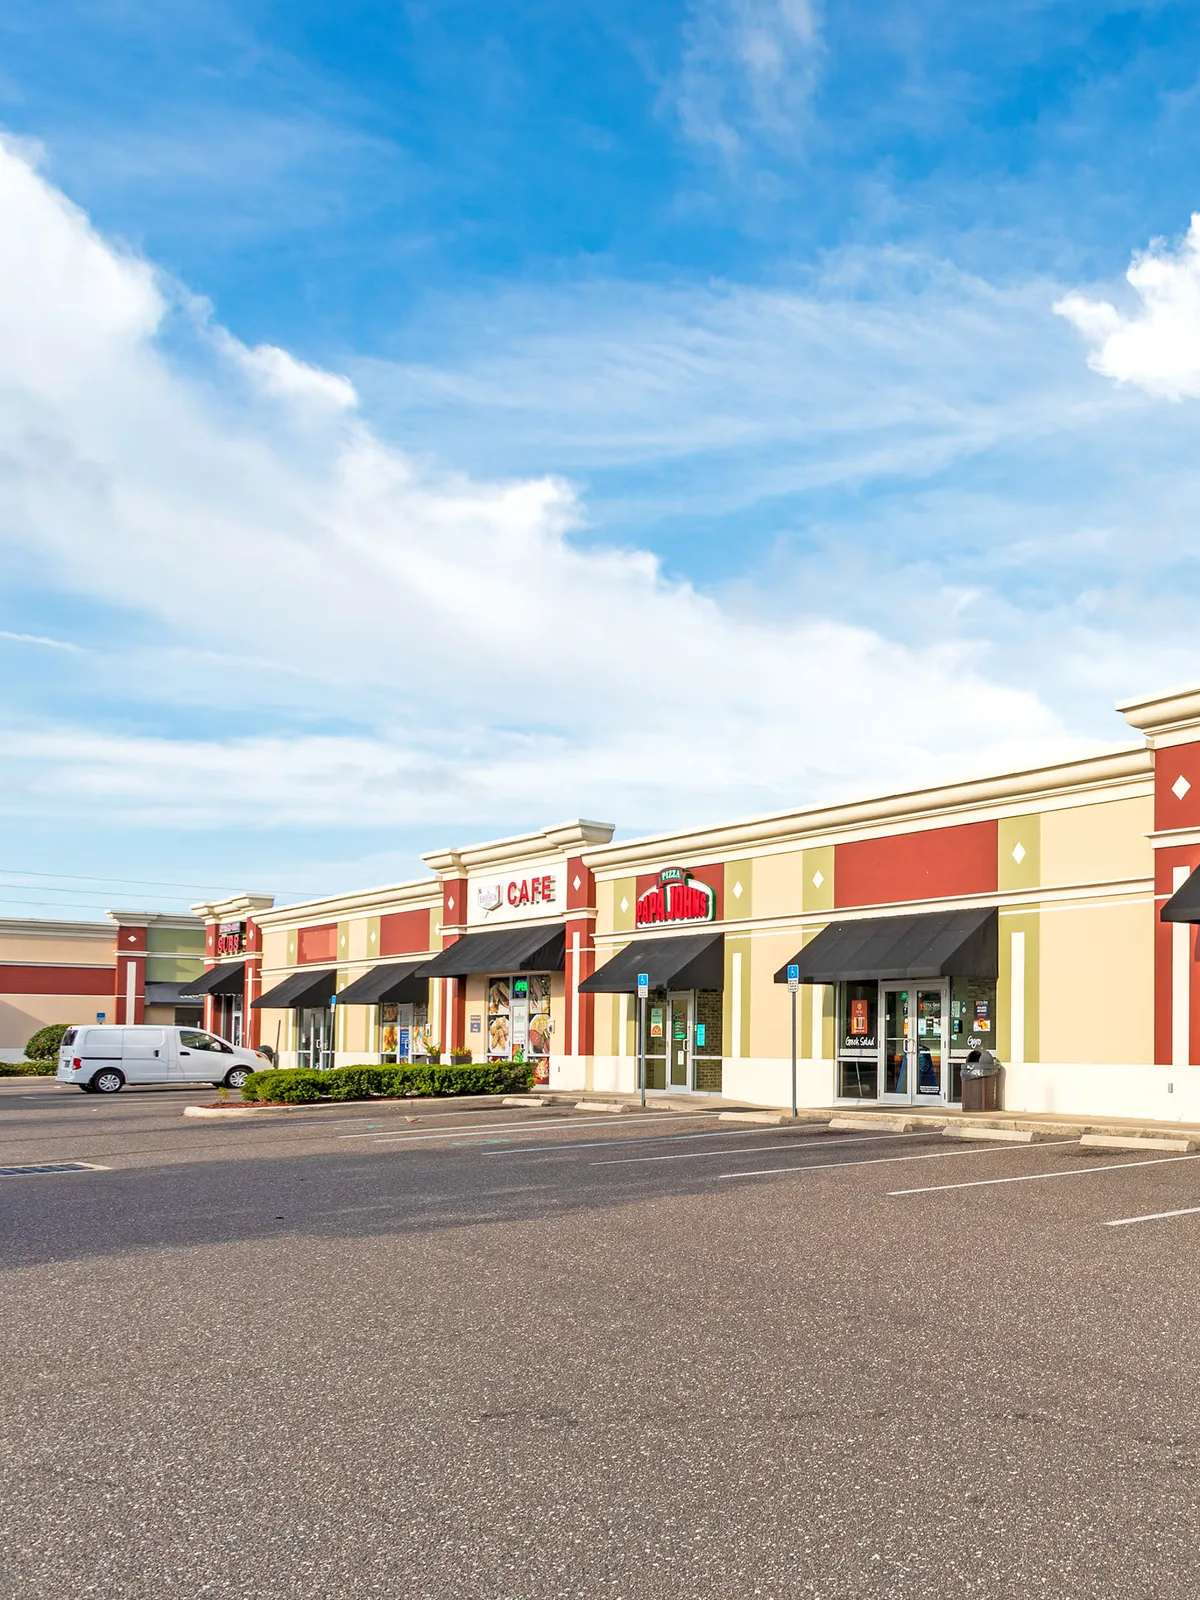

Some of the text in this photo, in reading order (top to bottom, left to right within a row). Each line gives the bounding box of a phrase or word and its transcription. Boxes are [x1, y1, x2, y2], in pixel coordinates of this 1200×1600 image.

[661, 869, 681, 881] PIZZA
[507, 875, 551, 905] CAFE
[636, 884, 707, 924] PAPA JOHNS
[218, 934, 240, 953] SUBS
